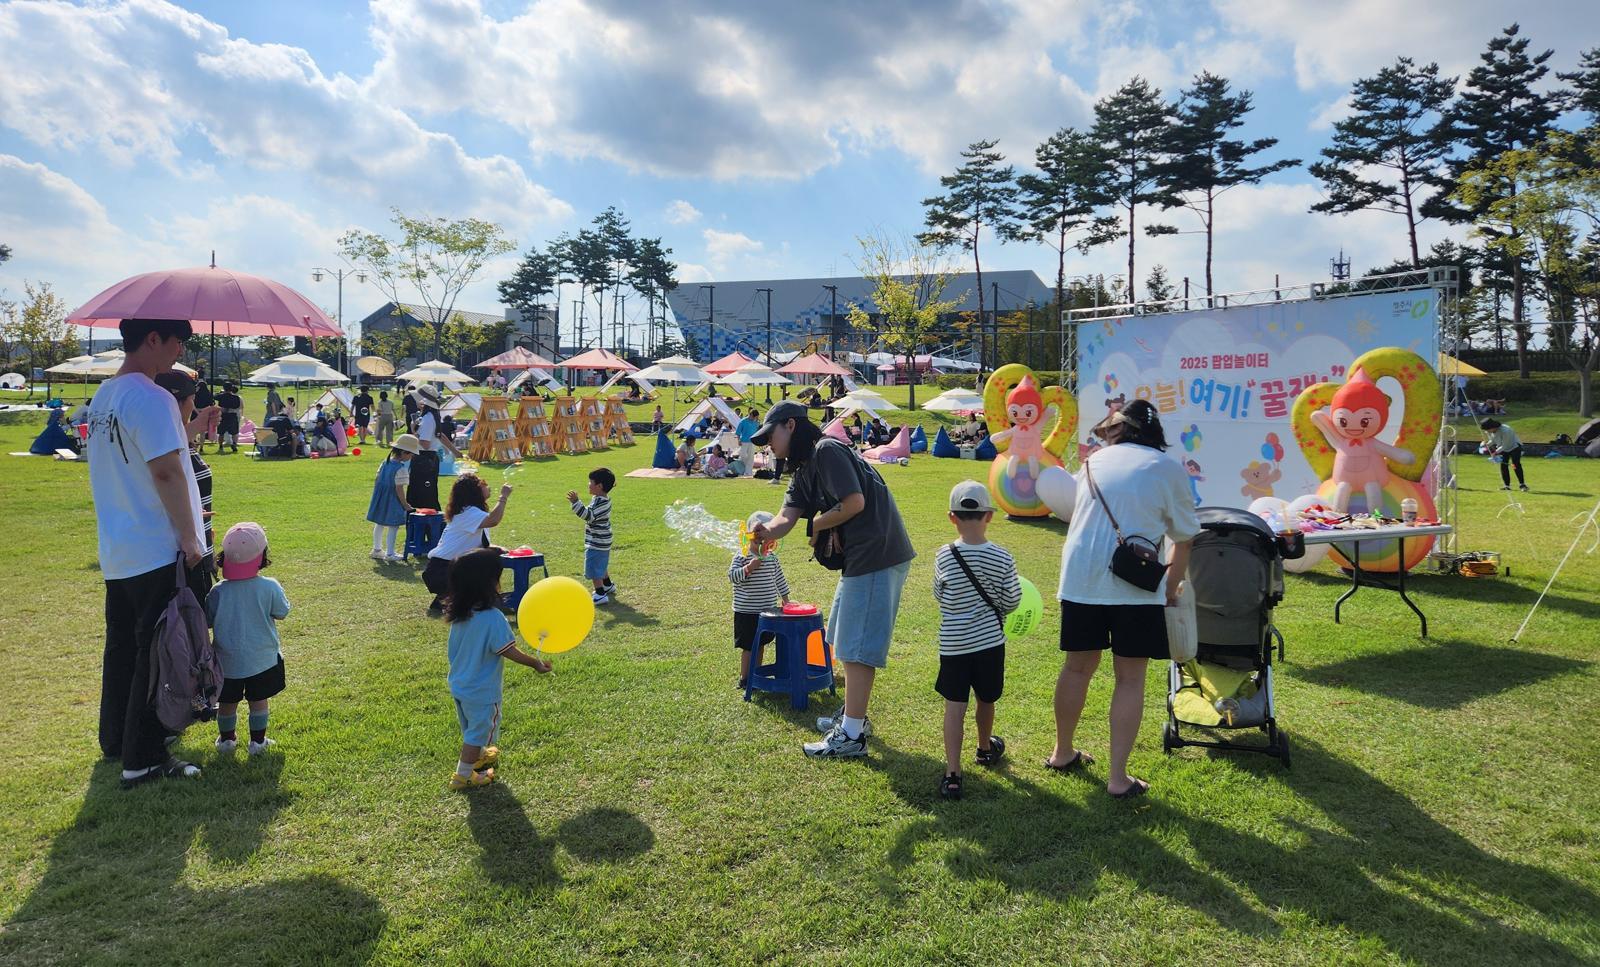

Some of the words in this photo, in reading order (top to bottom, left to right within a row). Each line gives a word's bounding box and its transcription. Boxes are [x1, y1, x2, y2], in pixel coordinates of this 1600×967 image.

[1180, 357, 1208, 370] 2025
[1212, 353, 1269, 370] 팝업놀이터
[1190, 377, 1251, 419] 여기!
